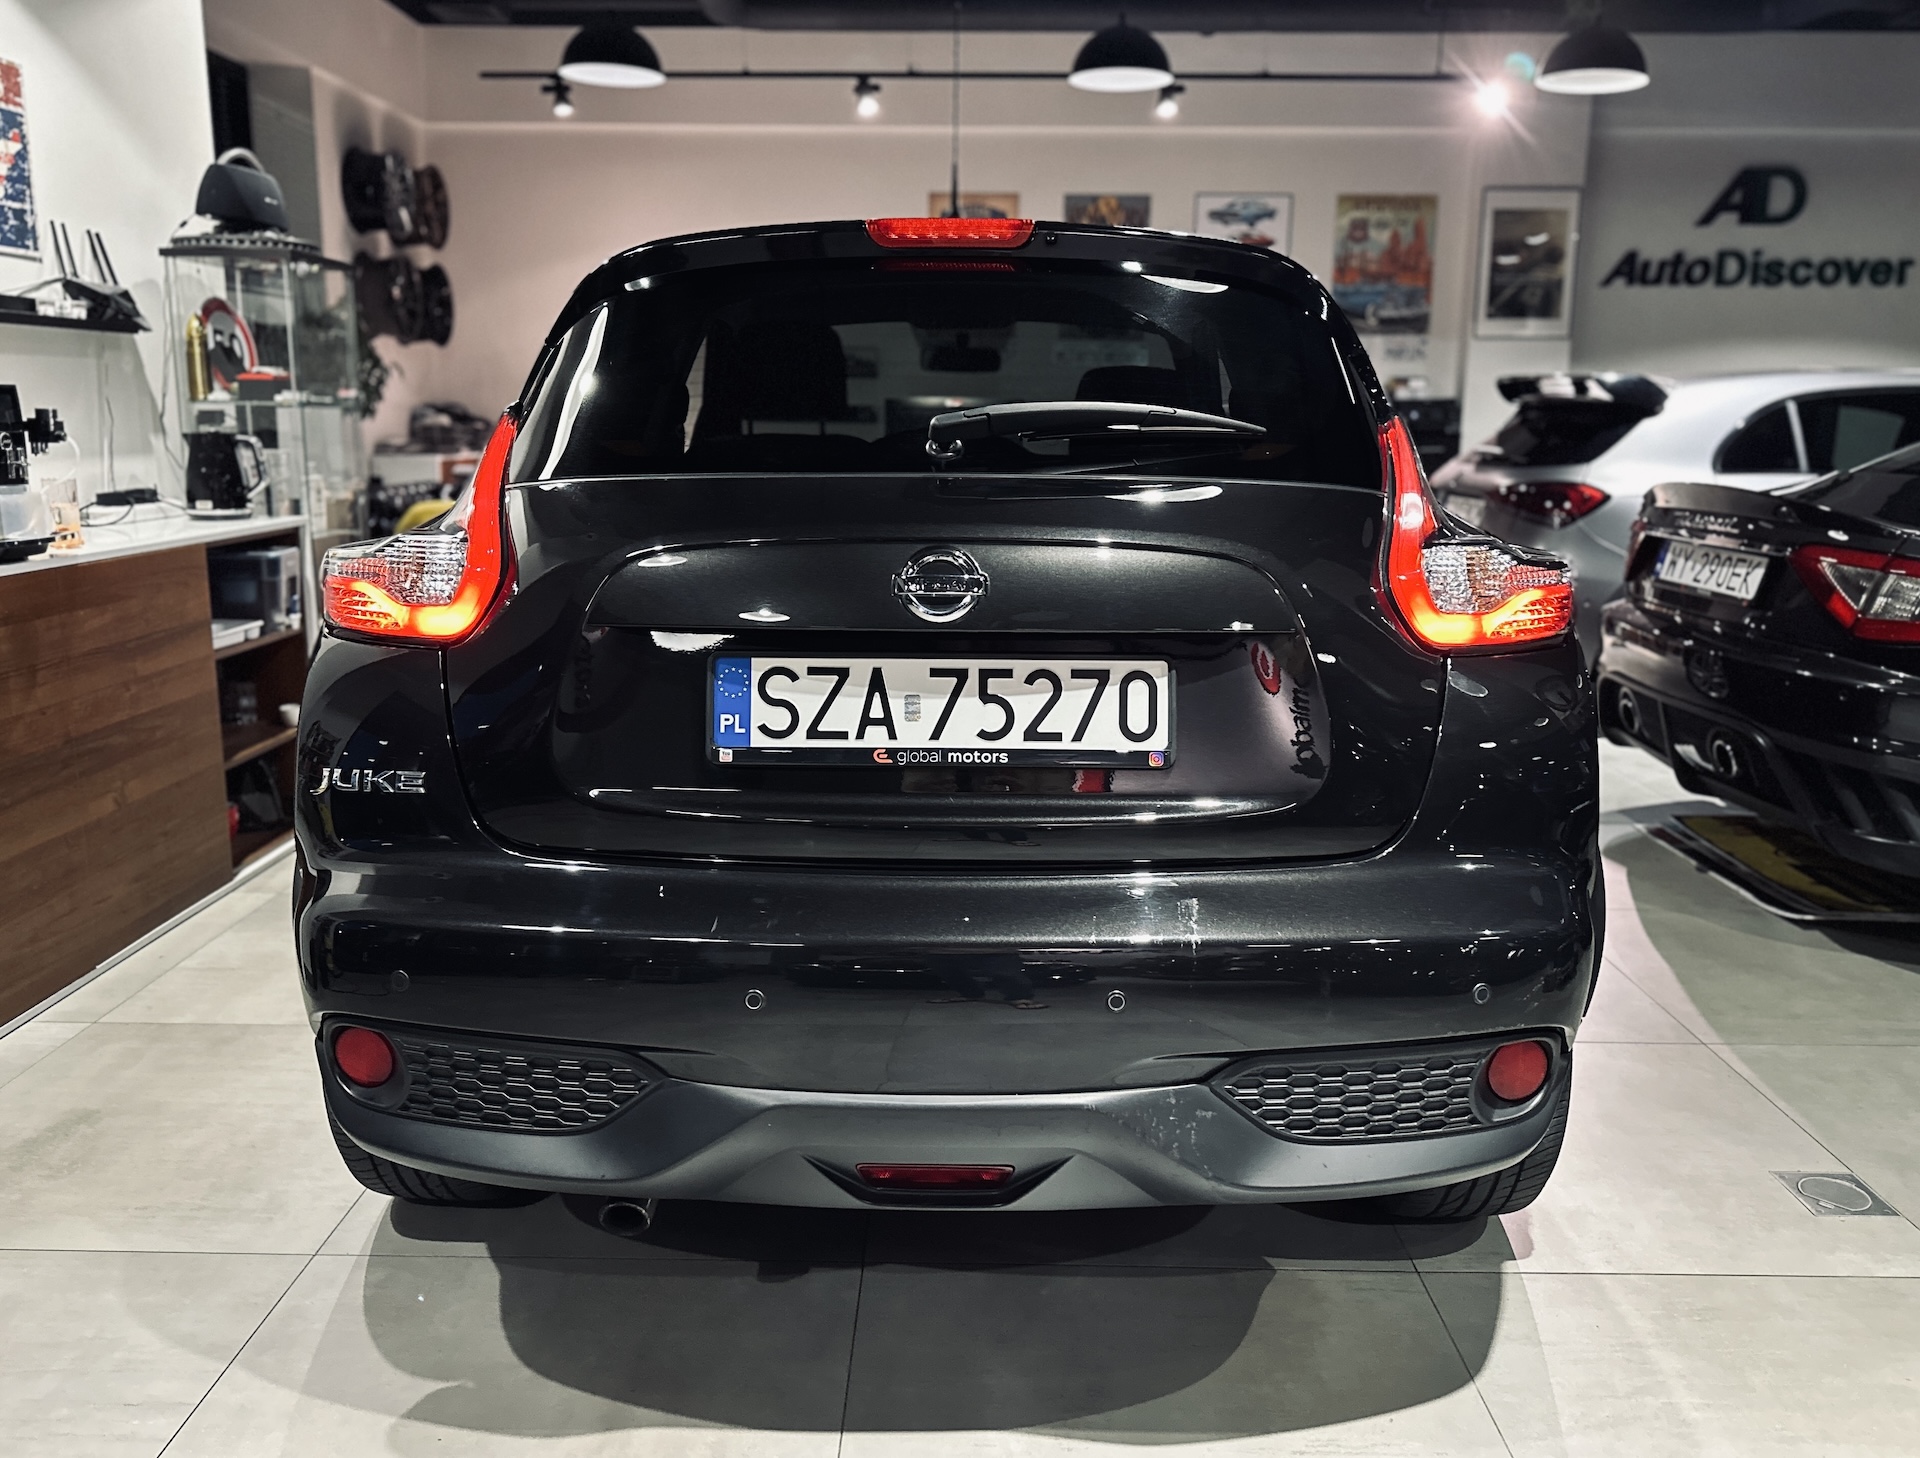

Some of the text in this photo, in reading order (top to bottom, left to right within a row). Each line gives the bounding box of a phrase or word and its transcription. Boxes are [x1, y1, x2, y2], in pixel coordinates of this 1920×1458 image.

[1601, 248, 1914, 287] AutoDiscover
[1693, 551, 1762, 595] 290EK
[757, 666, 1158, 743] SZA 75270
[719, 714, 746, 734] PL
[896, 749, 1010, 766] global motors
[309, 768, 427, 795] JUKE
